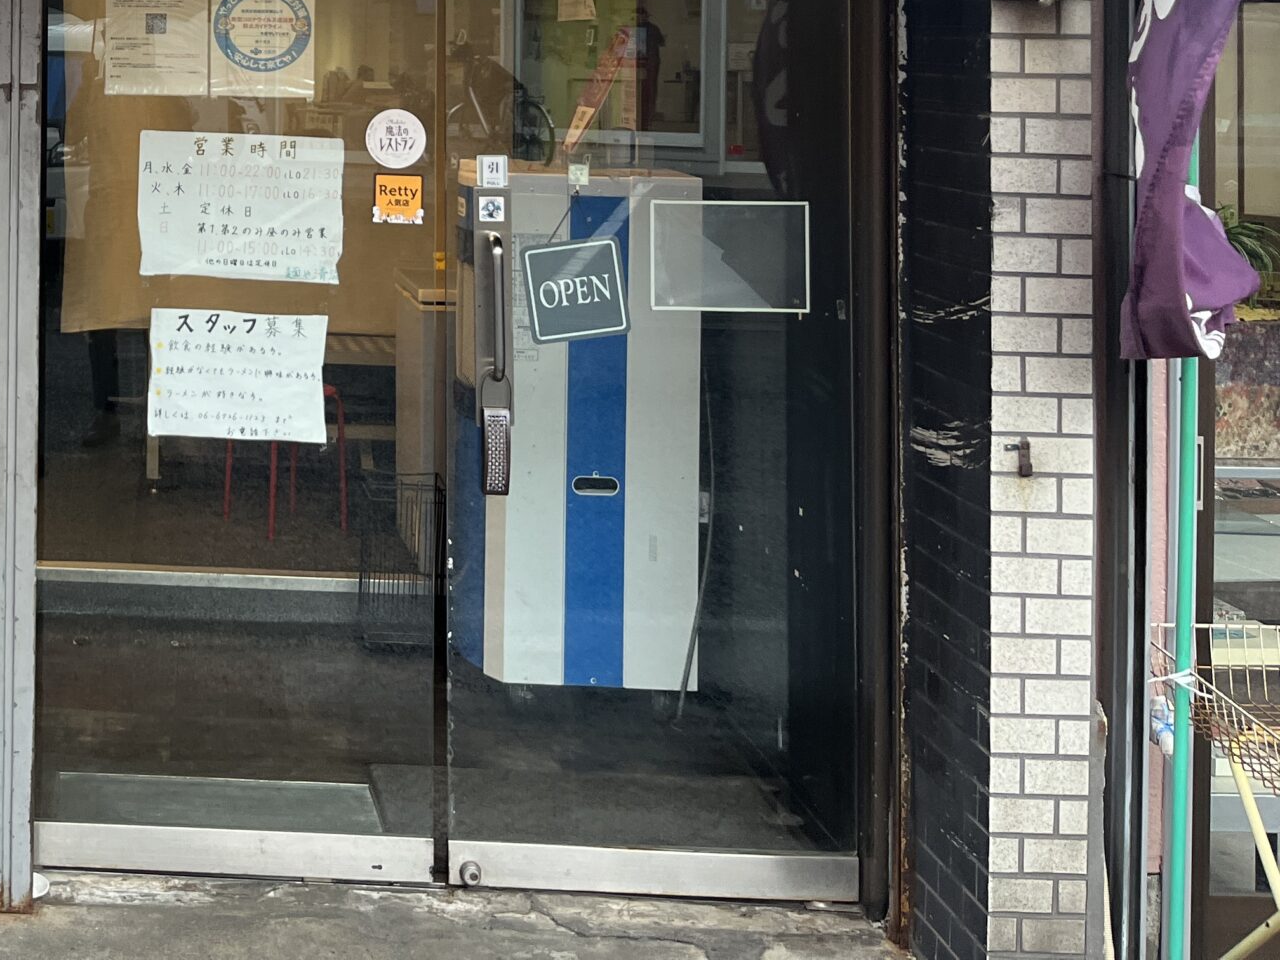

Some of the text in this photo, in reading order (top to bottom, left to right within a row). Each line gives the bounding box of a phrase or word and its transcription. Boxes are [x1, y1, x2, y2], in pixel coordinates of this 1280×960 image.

[385, 126, 409, 137] 魔法の
[193, 136, 298, 159] 営業時間
[379, 137, 416, 152] レストラン
[488, 161, 500, 174] 引
[379, 184, 419, 200] Retty
[160, 201, 252, 218] 土 定休日
[386, 198, 410, 207] 人気店
[539, 273, 612, 309] OPEN
[176, 313, 308, 338] スタッフ募集
